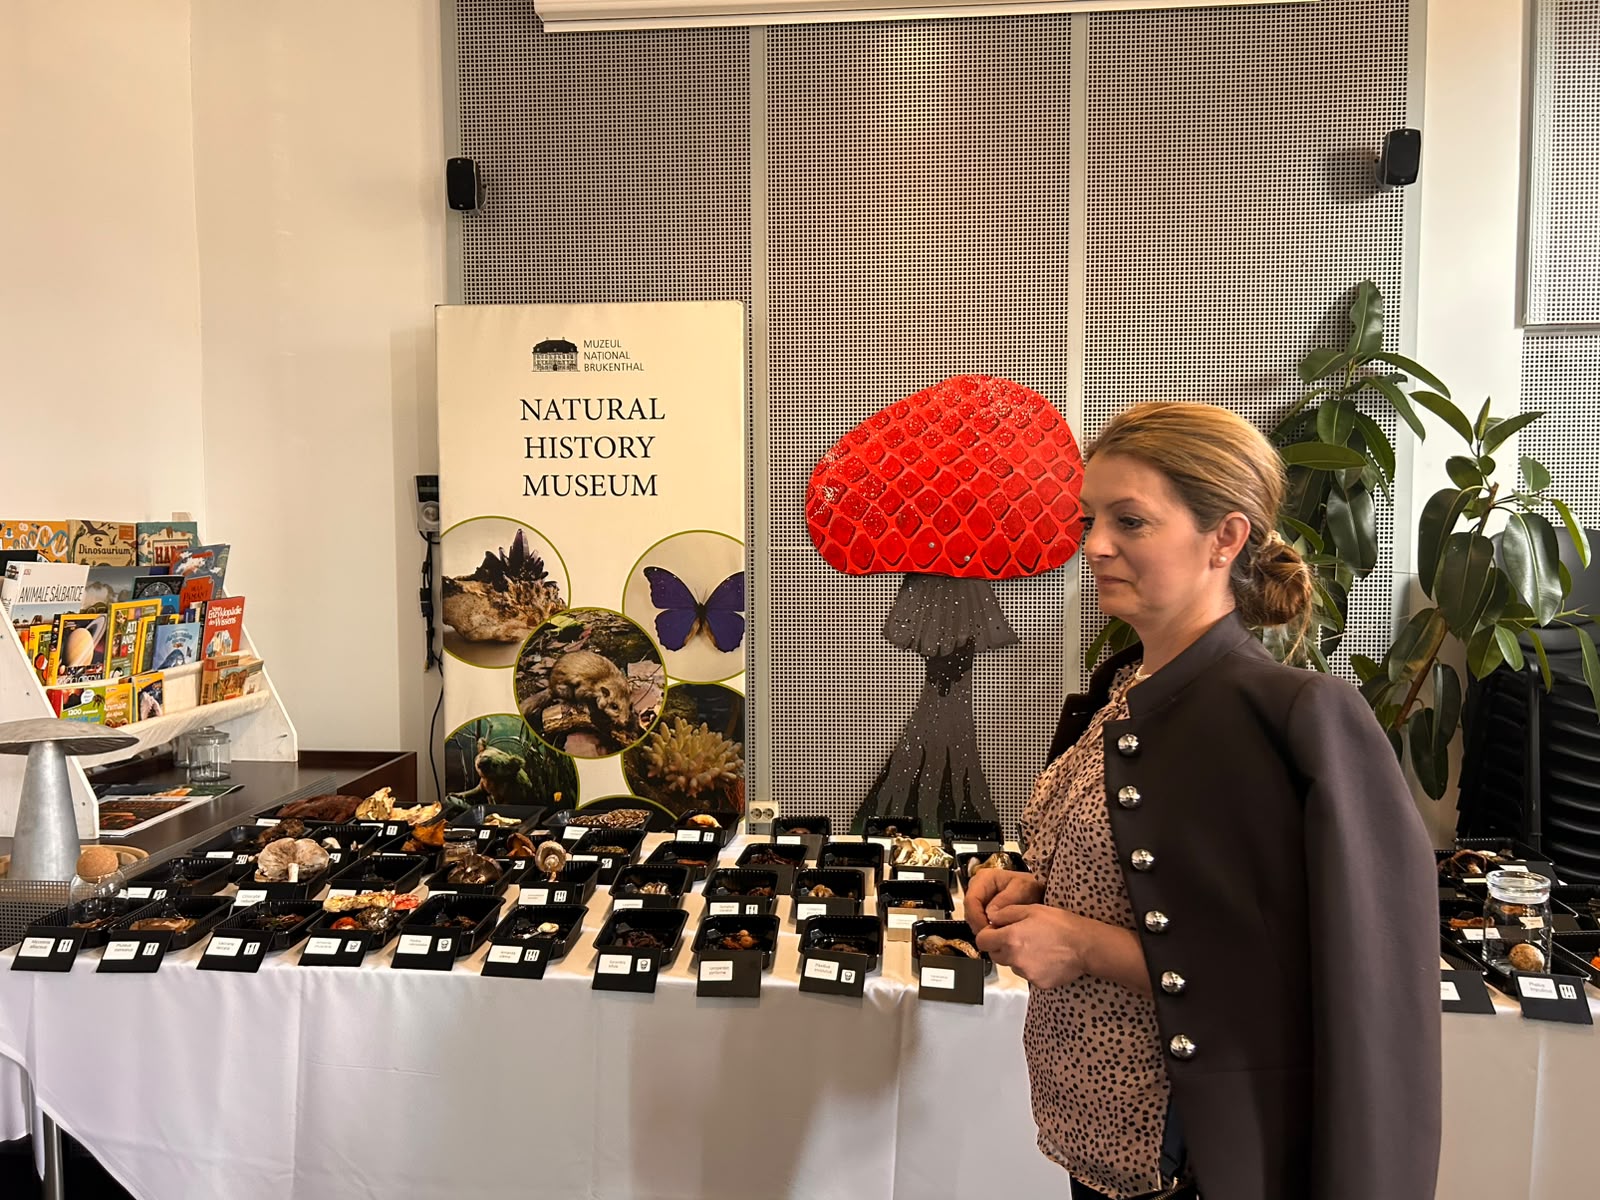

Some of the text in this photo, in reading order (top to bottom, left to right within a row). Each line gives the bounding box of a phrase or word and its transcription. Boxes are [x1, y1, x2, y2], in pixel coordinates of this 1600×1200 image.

[583, 339, 622, 348] MUZEUL
[584, 362, 645, 372] BRUKENTHAL
[520, 398, 665, 421] NATURAL
[524, 436, 656, 459] HISTORY
[522, 474, 658, 497] MUSEUM
[78, 543, 131, 555] Dinosaurium
[18, 586, 50, 602] ANIMALE
